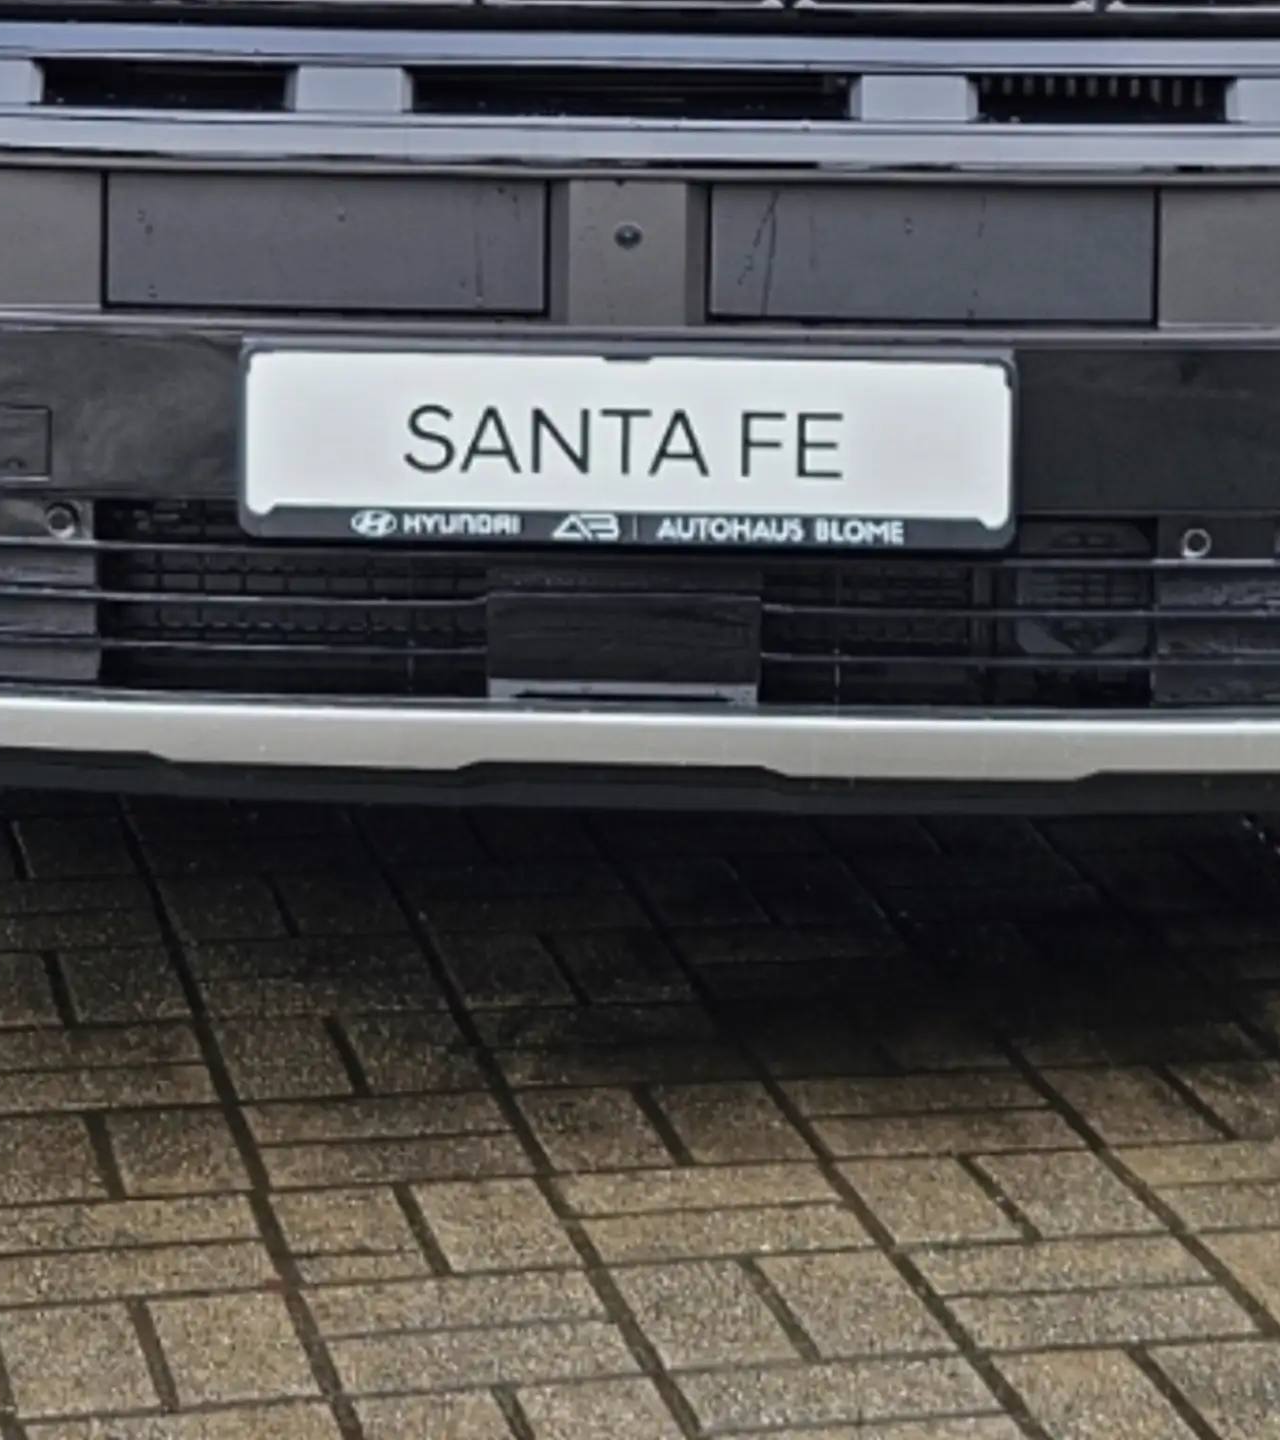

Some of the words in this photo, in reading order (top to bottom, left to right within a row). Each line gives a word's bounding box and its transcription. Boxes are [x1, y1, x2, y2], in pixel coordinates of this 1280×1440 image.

[404, 404, 709, 477] SANTA
[740, 411, 843, 479] FE
[403, 513, 521, 536] HYUNDAI
[655, 516, 806, 543] AUTOHAUS
[815, 520, 905, 545] BLOME
